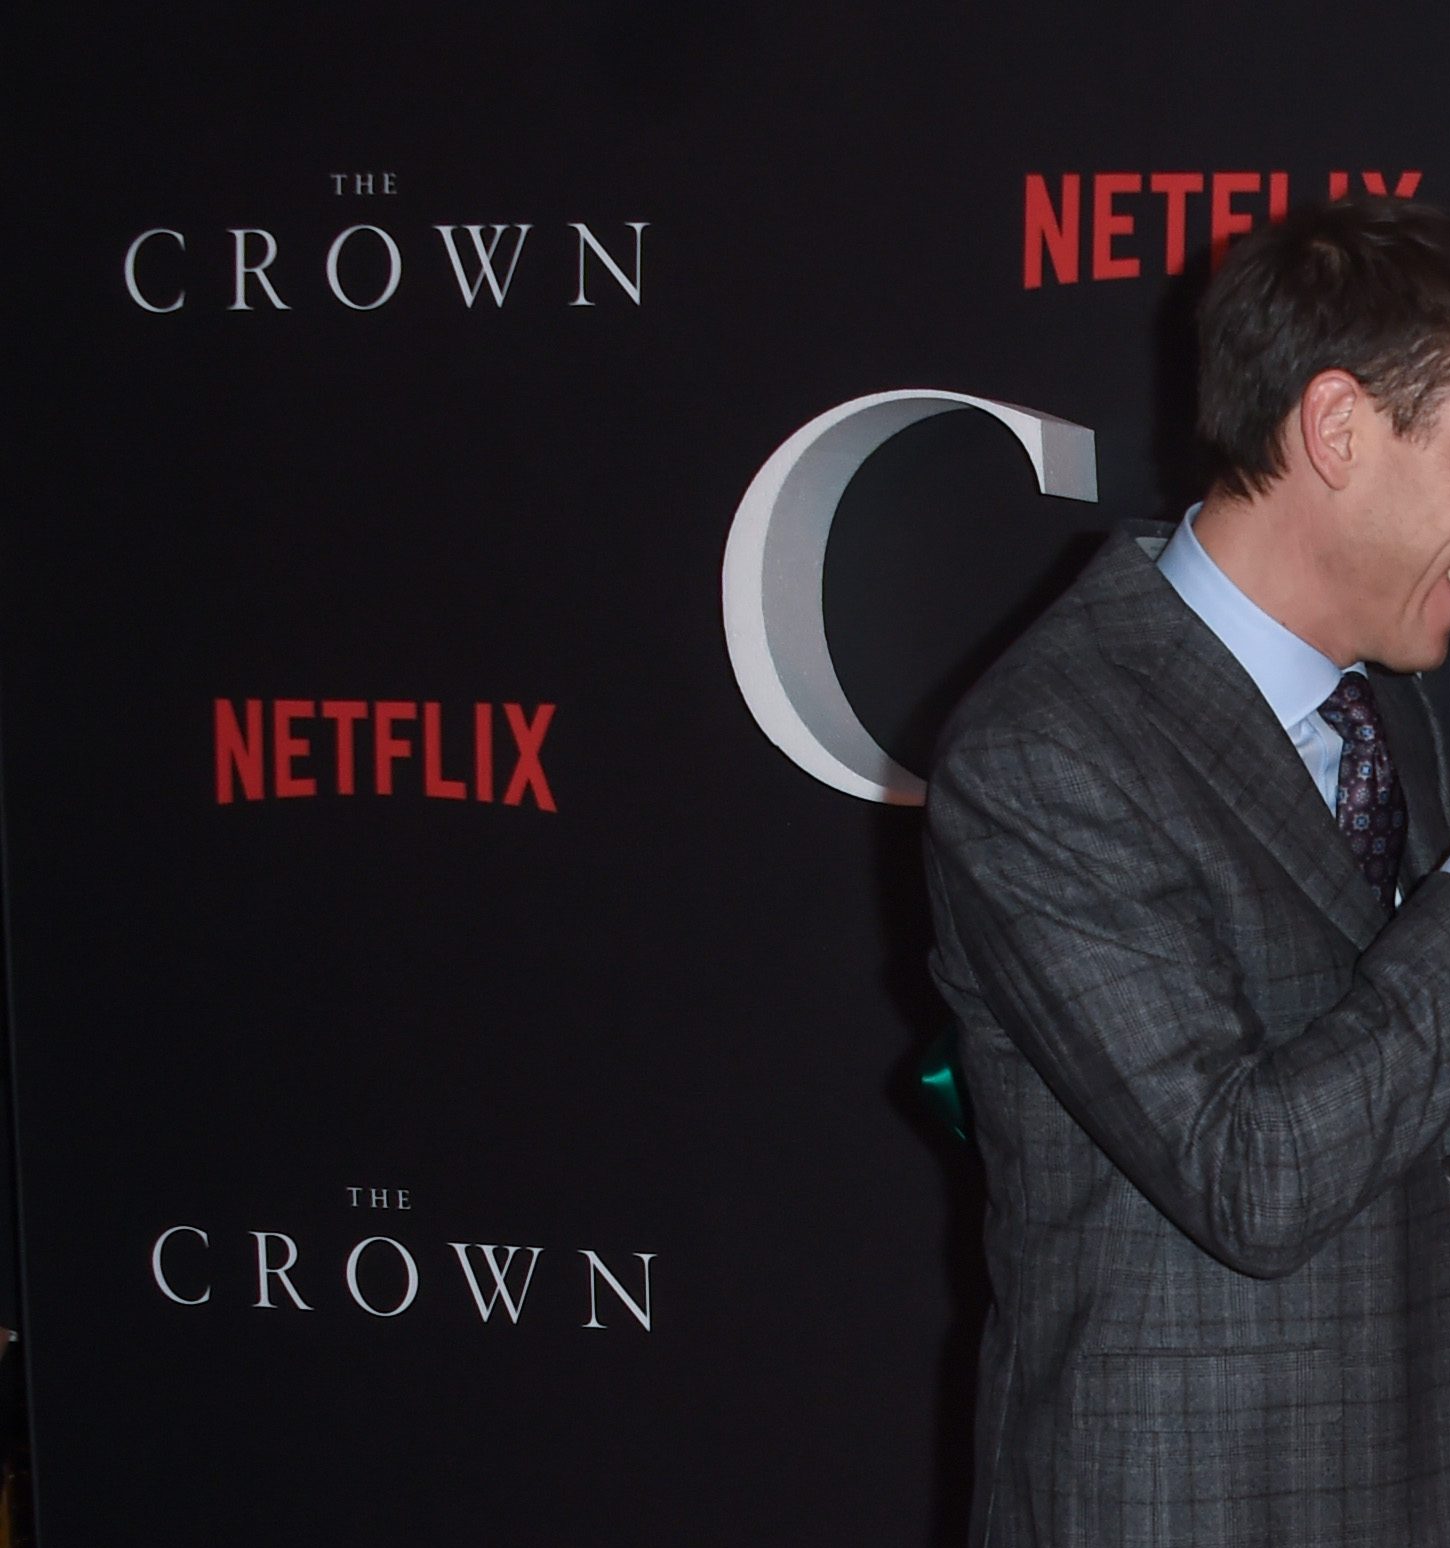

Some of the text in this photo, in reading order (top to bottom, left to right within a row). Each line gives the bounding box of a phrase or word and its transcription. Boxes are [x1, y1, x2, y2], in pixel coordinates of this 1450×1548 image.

[330, 172, 398, 196] THE
[1023, 171, 1422, 290] NETF
[124, 222, 651, 313] CROWN
[213, 697, 558, 813] NETFLIX
[346, 1186, 412, 1210] THE
[152, 1225, 658, 1332] CROWN
